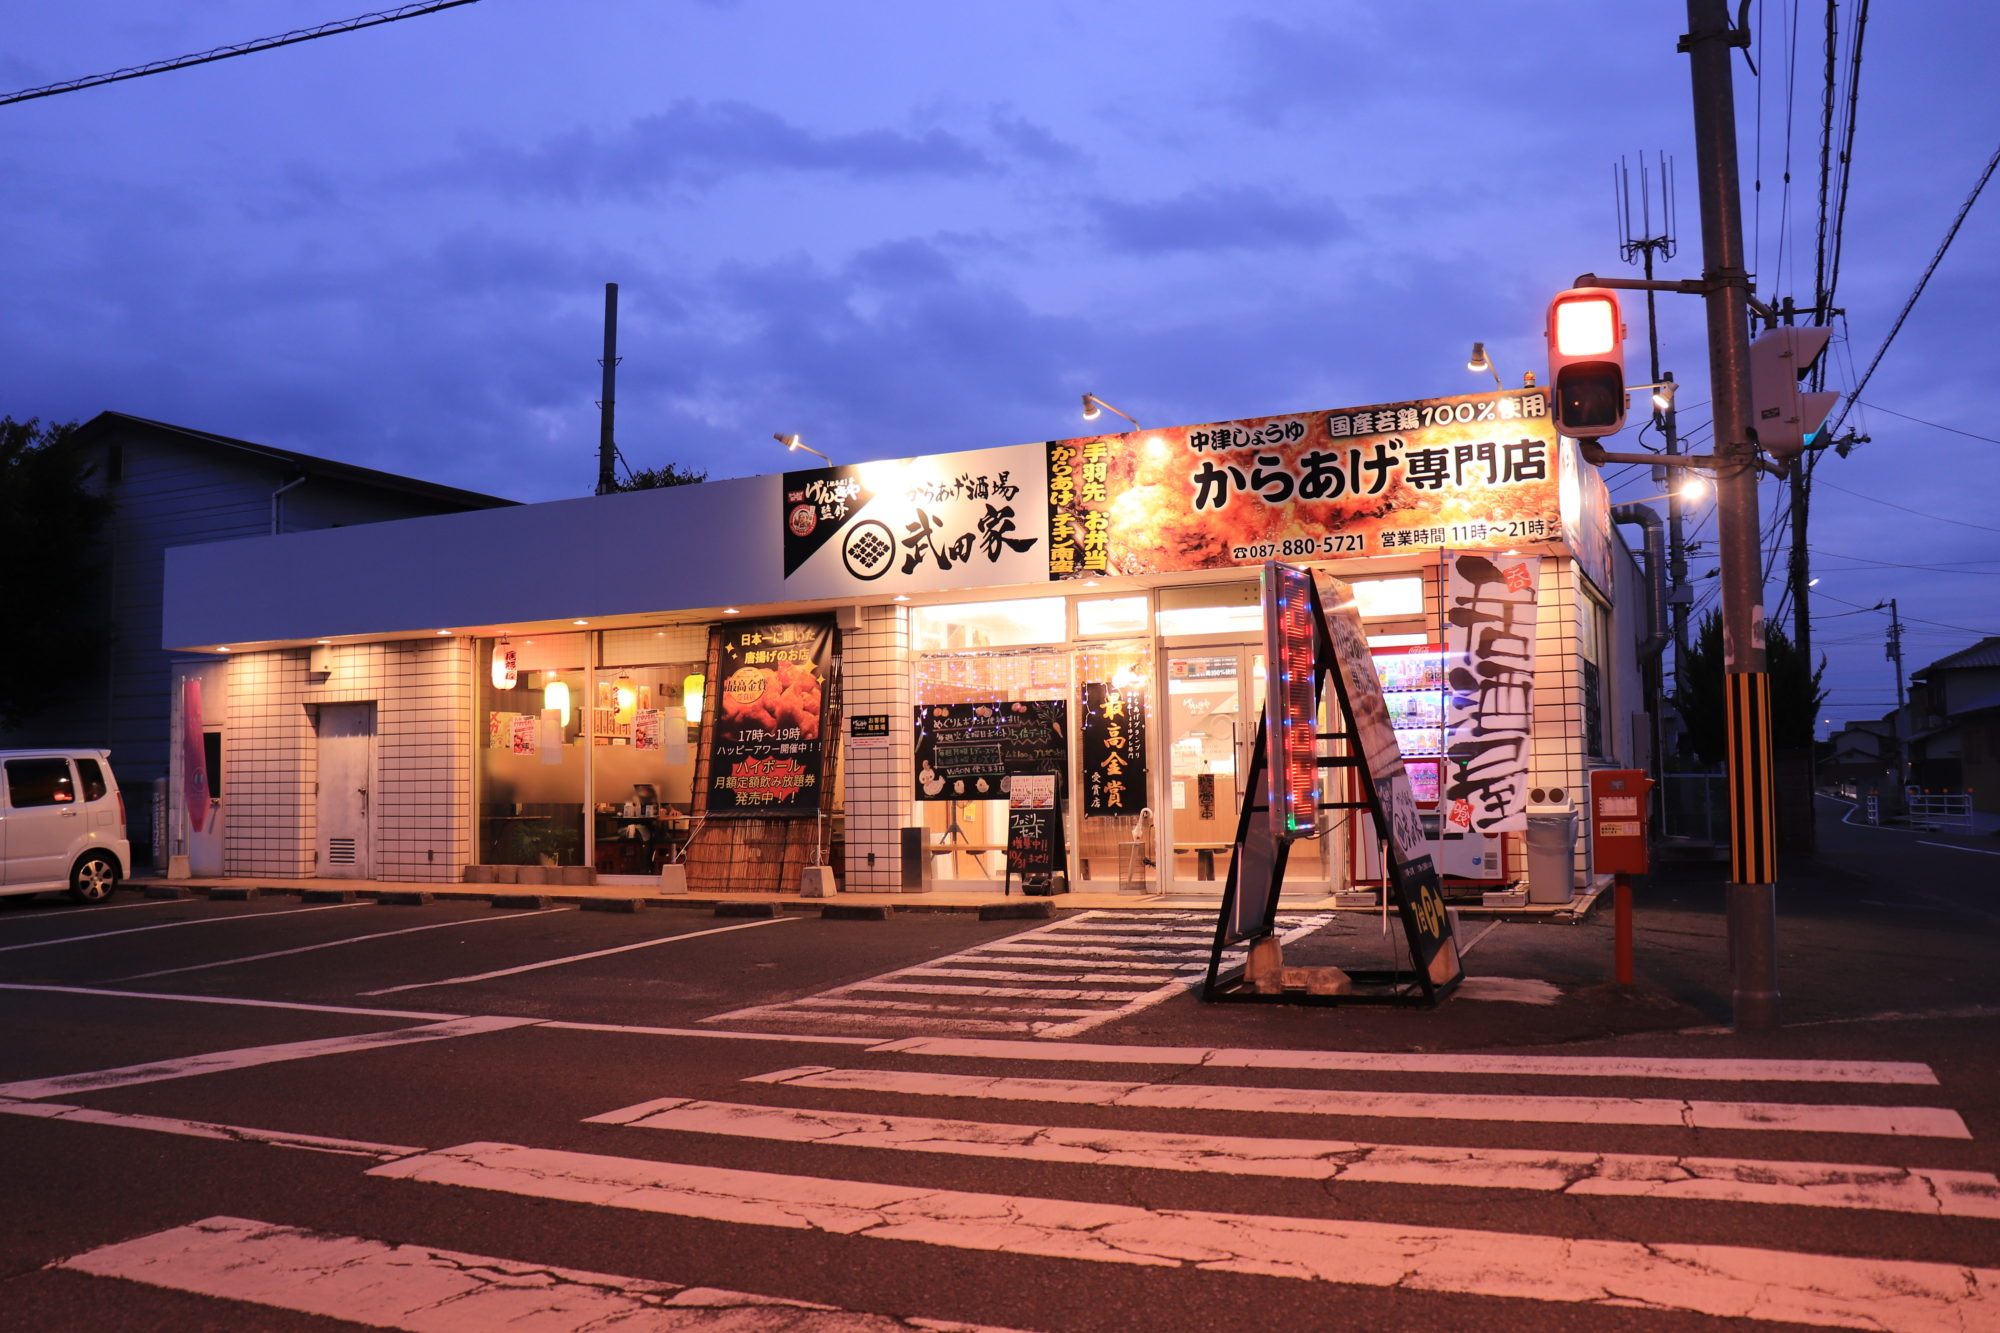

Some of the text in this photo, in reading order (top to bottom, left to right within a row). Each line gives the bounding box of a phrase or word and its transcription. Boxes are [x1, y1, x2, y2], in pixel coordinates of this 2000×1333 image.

[1190, 421, 1305, 452] 中津しょうゆ
[1194, 439, 1546, 510] からあげ専門店
[1049, 446, 1077, 573] からあげ チキン南蛮
[1082, 443, 1109, 570] 手羽先 お弁当
[901, 503, 1038, 574] 武田家
[1249, 534, 1364, 559] 087-880-5721
[1381, 526, 1446, 548] 営業時間
[742, 630, 816, 647] 日本一に輝いた
[744, 648, 811, 664] 唐揚げのお店
[1099, 691, 1129, 808] 最高金賞
[714, 774, 816, 789] 月額定額飲み放題券
[736, 759, 801, 774] ハイボール
[1090, 771, 1101, 808] 受賞店
